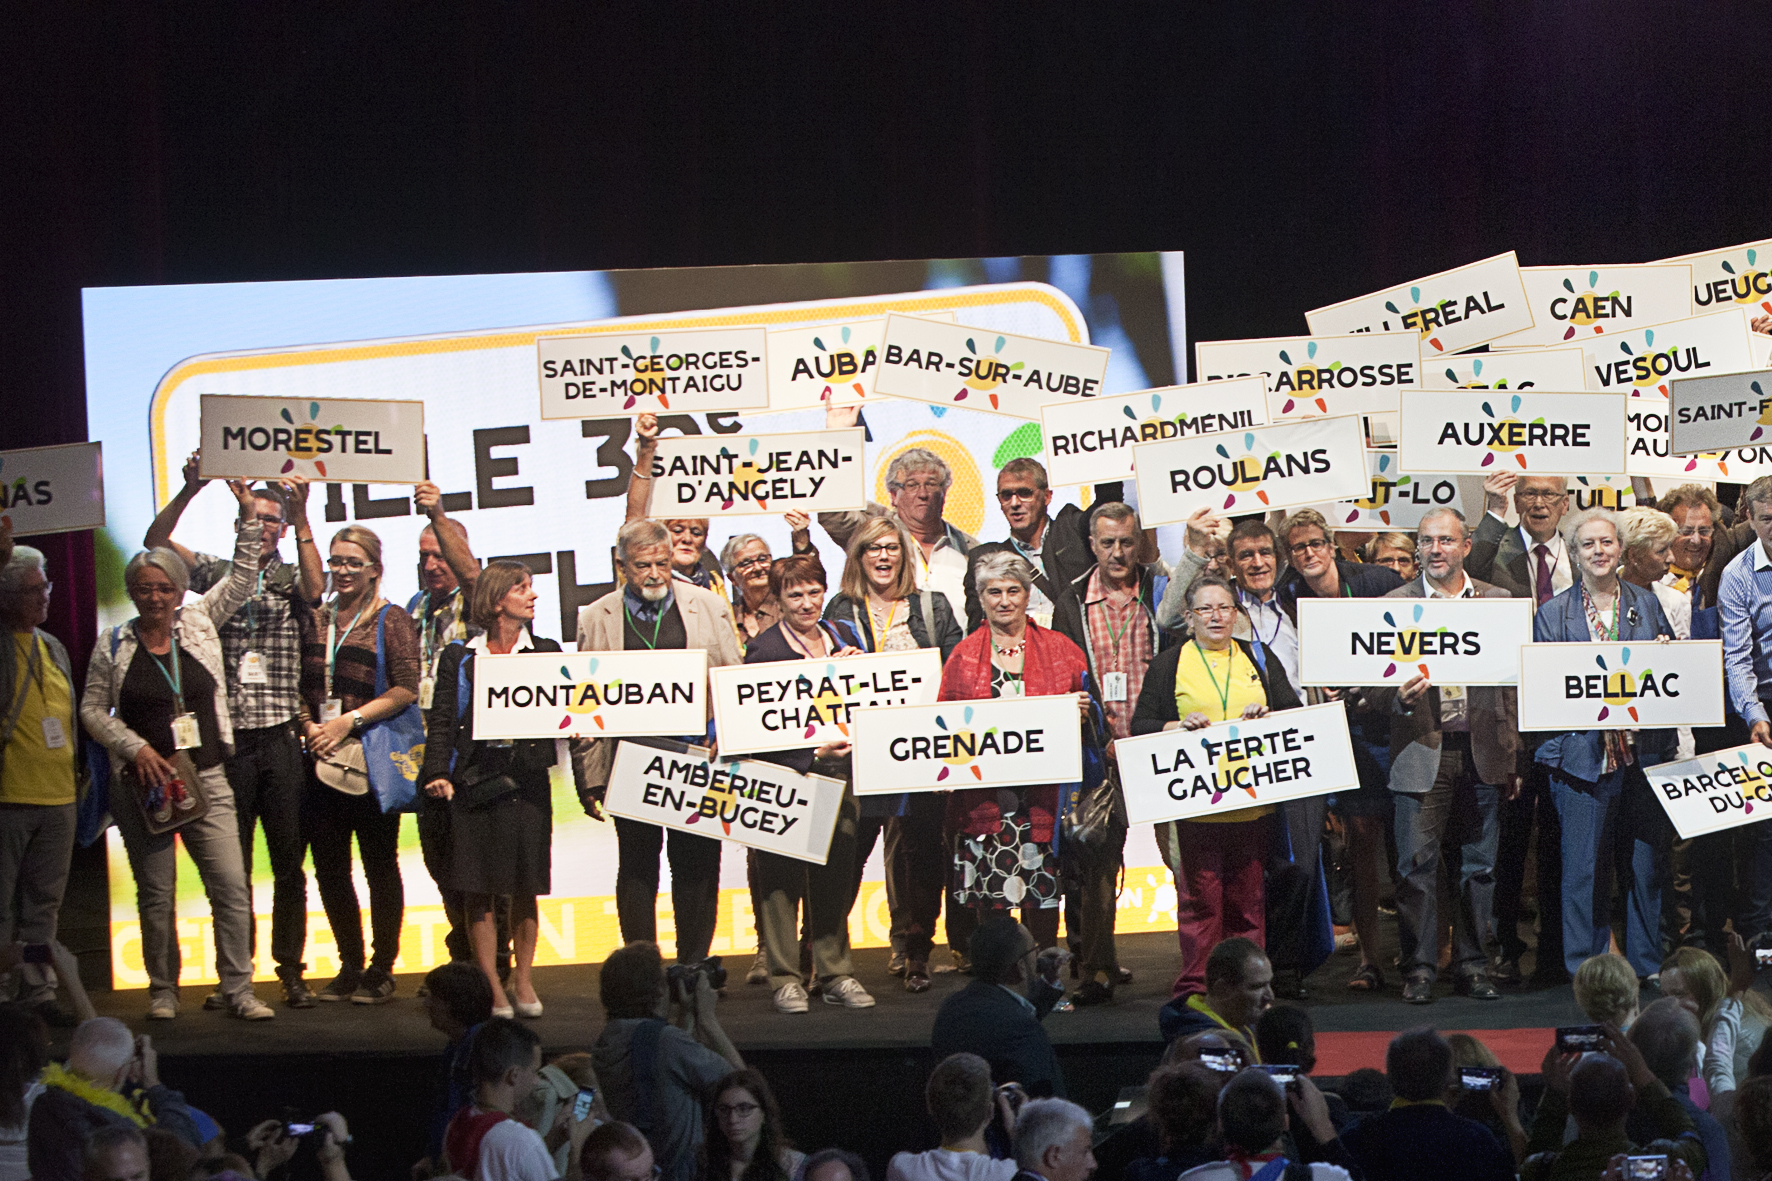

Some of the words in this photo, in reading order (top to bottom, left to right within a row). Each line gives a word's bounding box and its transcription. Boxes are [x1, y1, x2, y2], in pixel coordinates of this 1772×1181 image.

[1550, 295, 1632, 321] CAEN
[543, 352, 759, 378] SAINT-GEORGES-
[885, 345, 1099, 398] BAR-SUR-AUBE
[1595, 346, 1711, 386] VESOUL
[564, 374, 742, 400] DE-MONTAIGU
[222, 427, 392, 455] MORESTEL
[1439, 422, 1590, 446] AUXERRE
[651, 450, 852, 477] SAINT-JEAN-
[1170, 449, 1331, 494] ROULANS
[677, 477, 826, 503] D'ANGÉLY
[1351, 632, 1481, 655] NEVERS
[487, 683, 693, 707] MONTAUBAN
[737, 670, 921, 705] PEYRAT-LE-
[1565, 674, 1679, 698] BELLAC
[890, 730, 1044, 761] GRENADE
[1152, 749, 1191, 773] LA
[1206, 729, 1314, 764] FERTÉ-
[644, 756, 808, 807] AMBÉRIEU-
[1167, 757, 1311, 801] GAUCHER
[643, 784, 798, 835] EN-BUGEY
